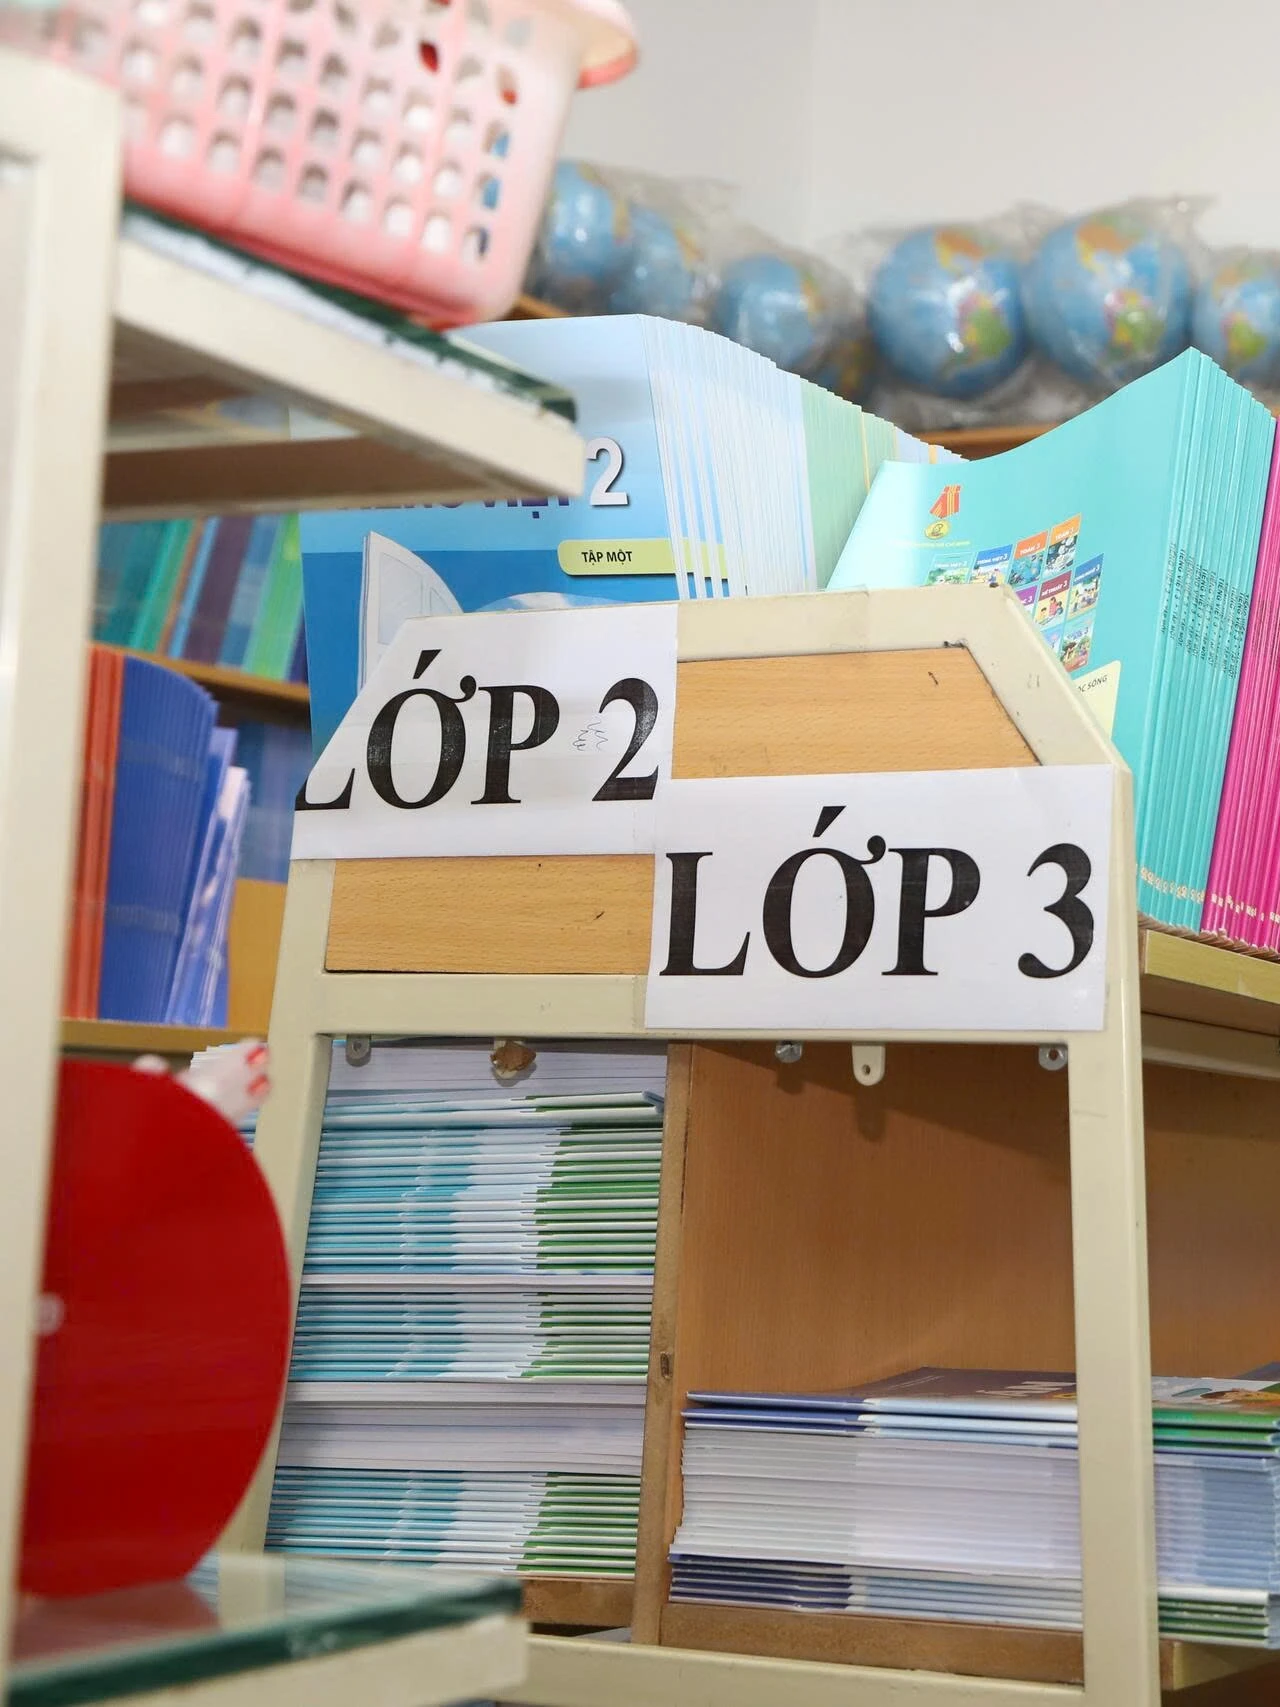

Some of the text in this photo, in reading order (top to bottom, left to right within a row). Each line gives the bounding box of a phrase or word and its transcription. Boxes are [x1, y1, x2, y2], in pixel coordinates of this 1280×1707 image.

[586, 436, 629, 507] 2
[581, 548, 633, 566] TẬP MỘT
[592, 677, 660, 802] 2
[659, 805, 1094, 978] LỚP 3
